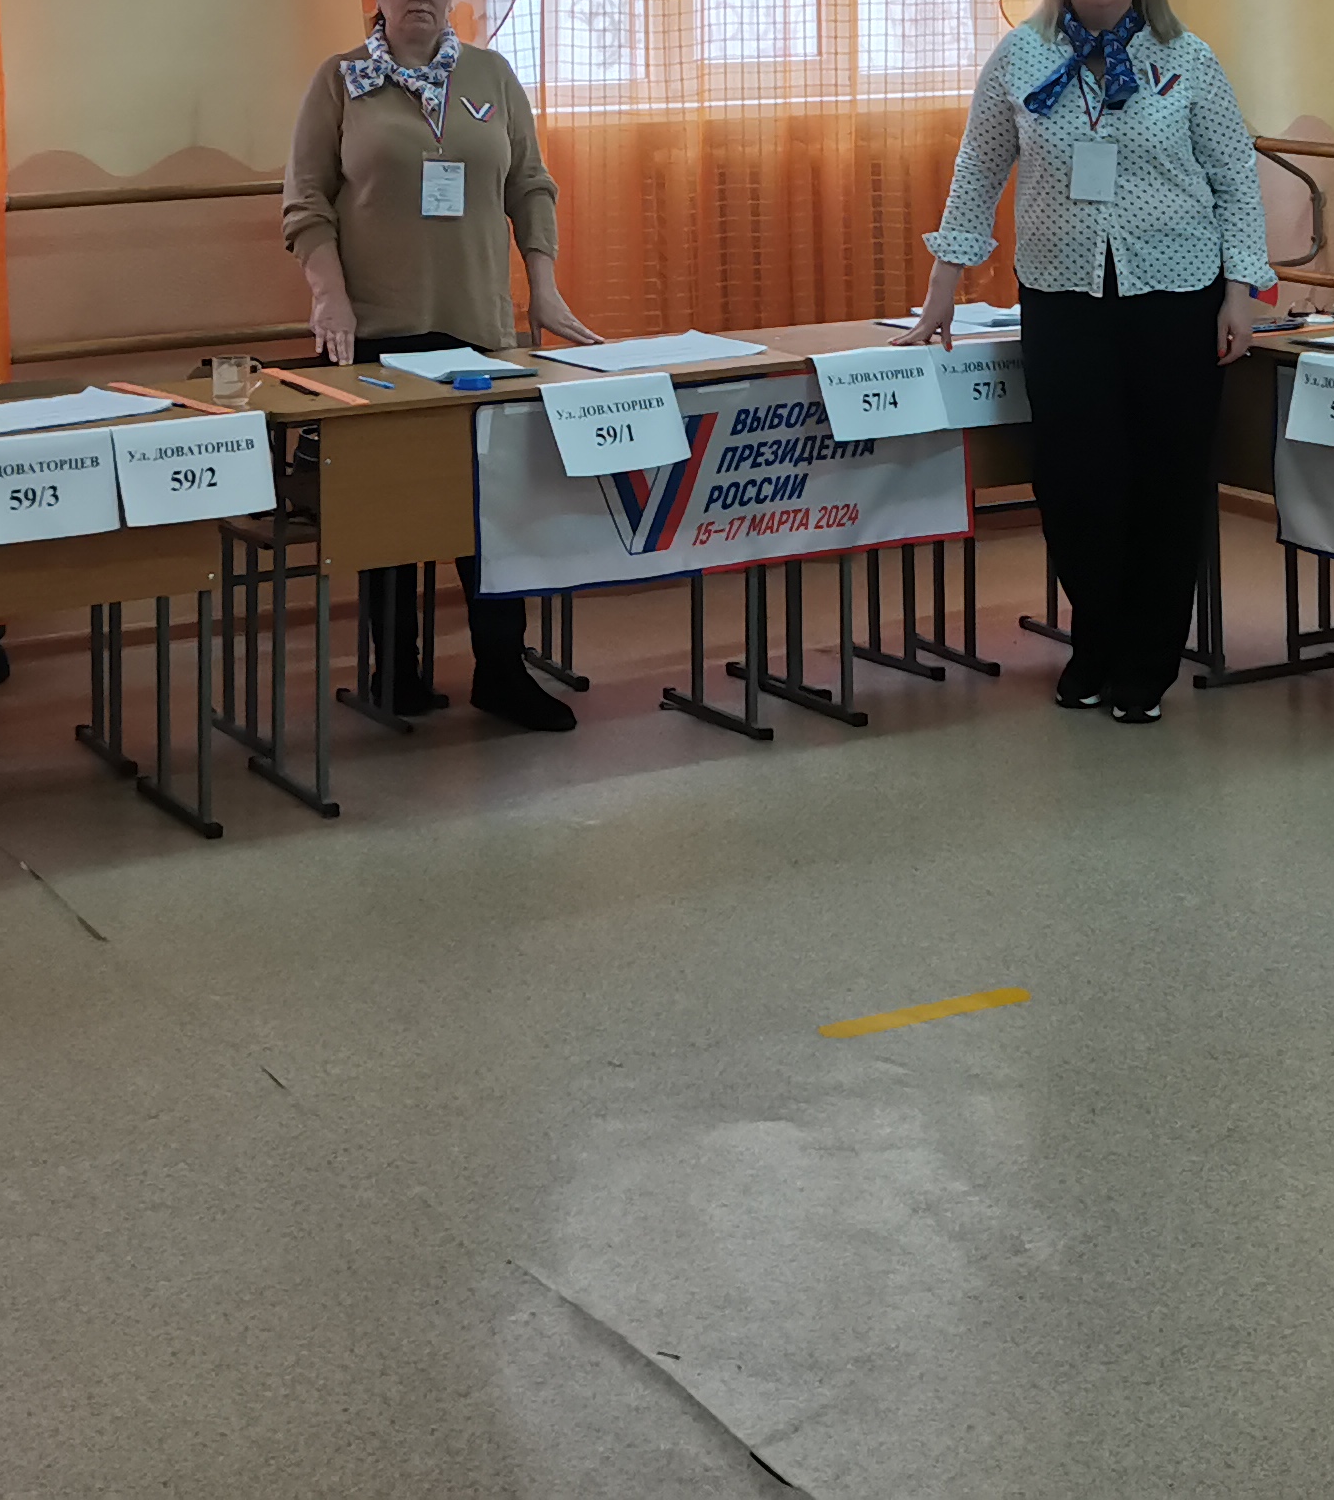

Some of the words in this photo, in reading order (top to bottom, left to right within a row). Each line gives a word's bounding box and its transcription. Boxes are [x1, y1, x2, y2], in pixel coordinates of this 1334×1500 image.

[847, 367, 925, 385] ДОВАТОРЦЕВ
[862, 390, 899, 412] 57/4
[972, 381, 1007, 401] 57/3
[578, 397, 665, 419] ДОВАТОРЦЕВ
[595, 423, 635, 447] 59/1
[153, 438, 255, 461] ДОВАТОРЦЕВ
[170, 467, 218, 492] 59/2
[9, 485, 59, 511] 59/3
[703, 472, 809, 514] РОССИИ
[745, 506, 811, 537] МАРТА
[814, 502, 859, 530] 2024
